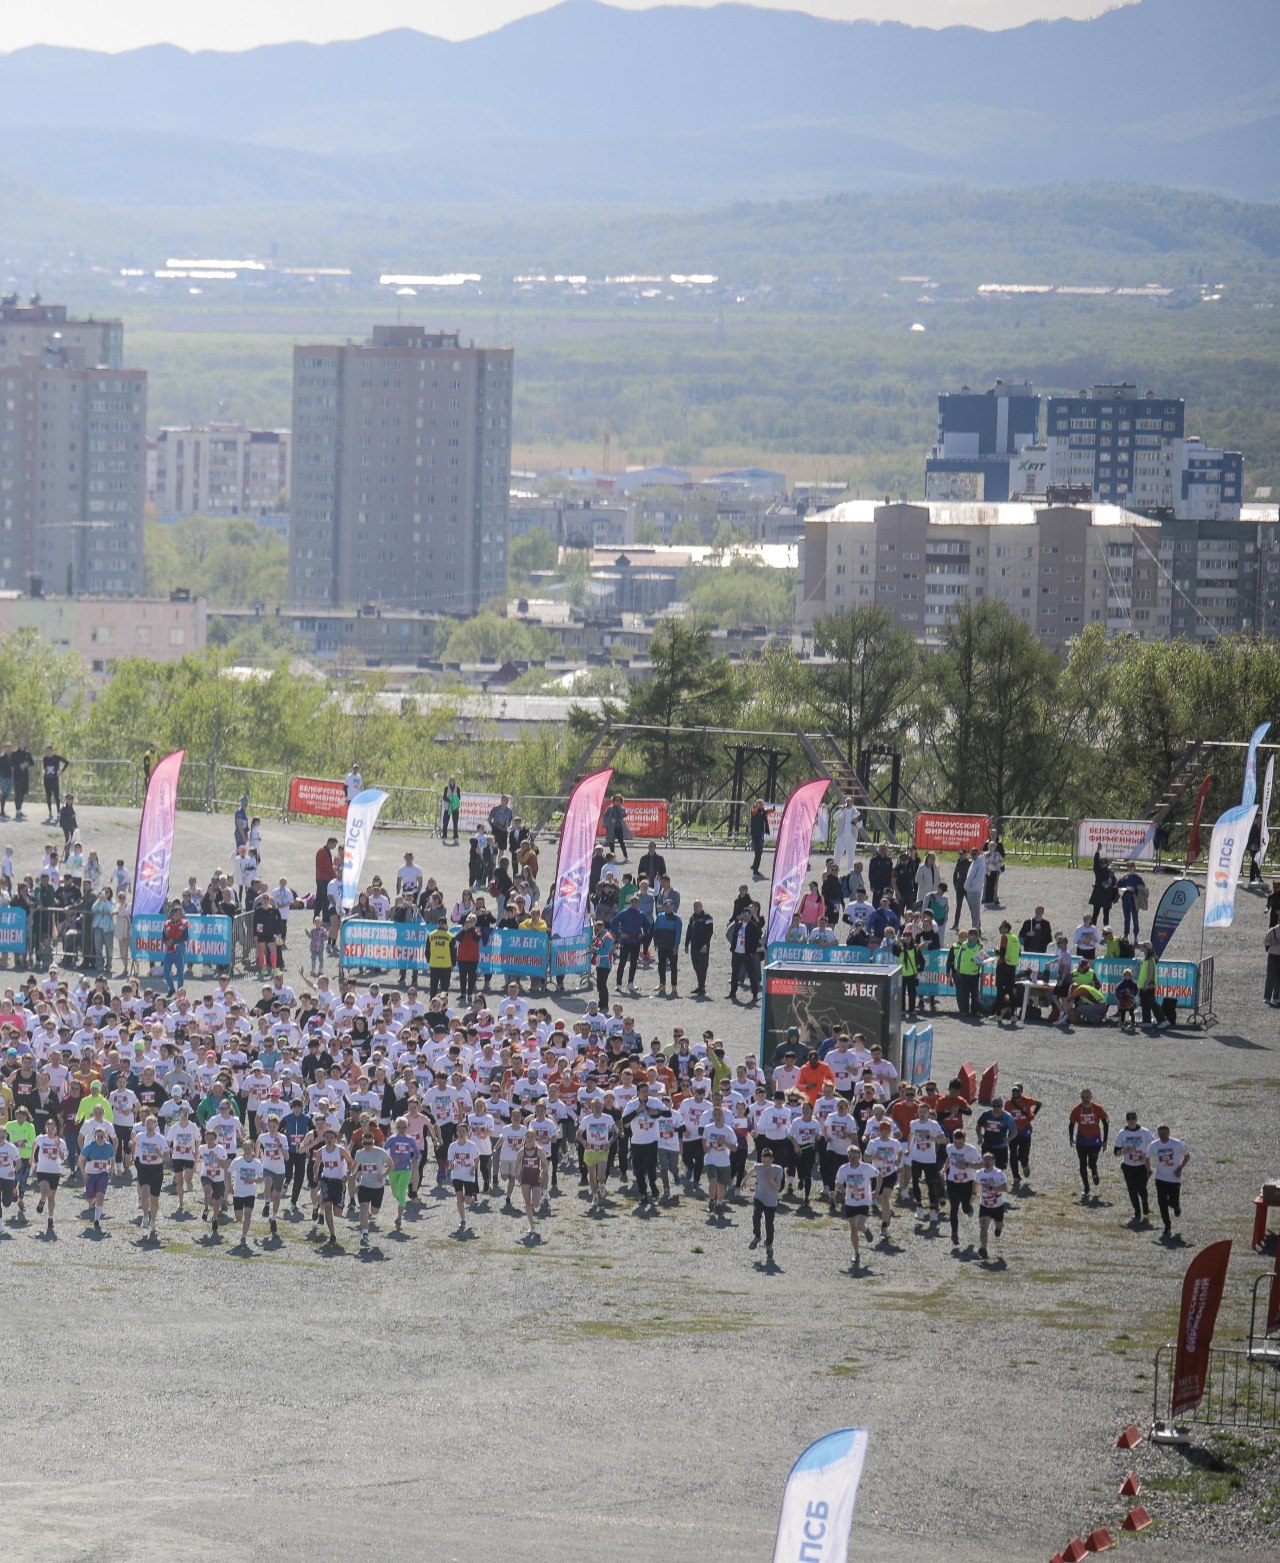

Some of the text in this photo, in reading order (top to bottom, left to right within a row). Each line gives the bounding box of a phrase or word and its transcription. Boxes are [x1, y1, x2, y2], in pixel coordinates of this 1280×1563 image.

[1018, 460, 1046, 471] XFIT
[299, 785, 344, 796] БЕЛОРУССКИ
[299, 793, 346, 803] ФИРМЕННЫ
[625, 807, 658, 815] РУССКИЙ
[925, 821, 980, 830] БЕЛОРУССКИЙ
[346, 819, 363, 848] ПСБ
[925, 828, 979, 838] ФИРМЕННЫЙ
[1089, 828, 1145, 836] БЕЛОРУССКИЙ
[1089, 835, 1145, 844] ФИРМЕННЫЙ
[1219, 838, 1234, 868] ПСБ
[347, 926, 397, 940] #ЗАБЕГ2025
[194, 941, 226, 956] РАМКИ
[344, 943, 366, 958] БЕГУ
[368, 944, 394, 960] ВСЕМ
[772, 947, 823, 961] #ЗАБЕГ2025
[799, 1500, 829, 1563] ПСБ
